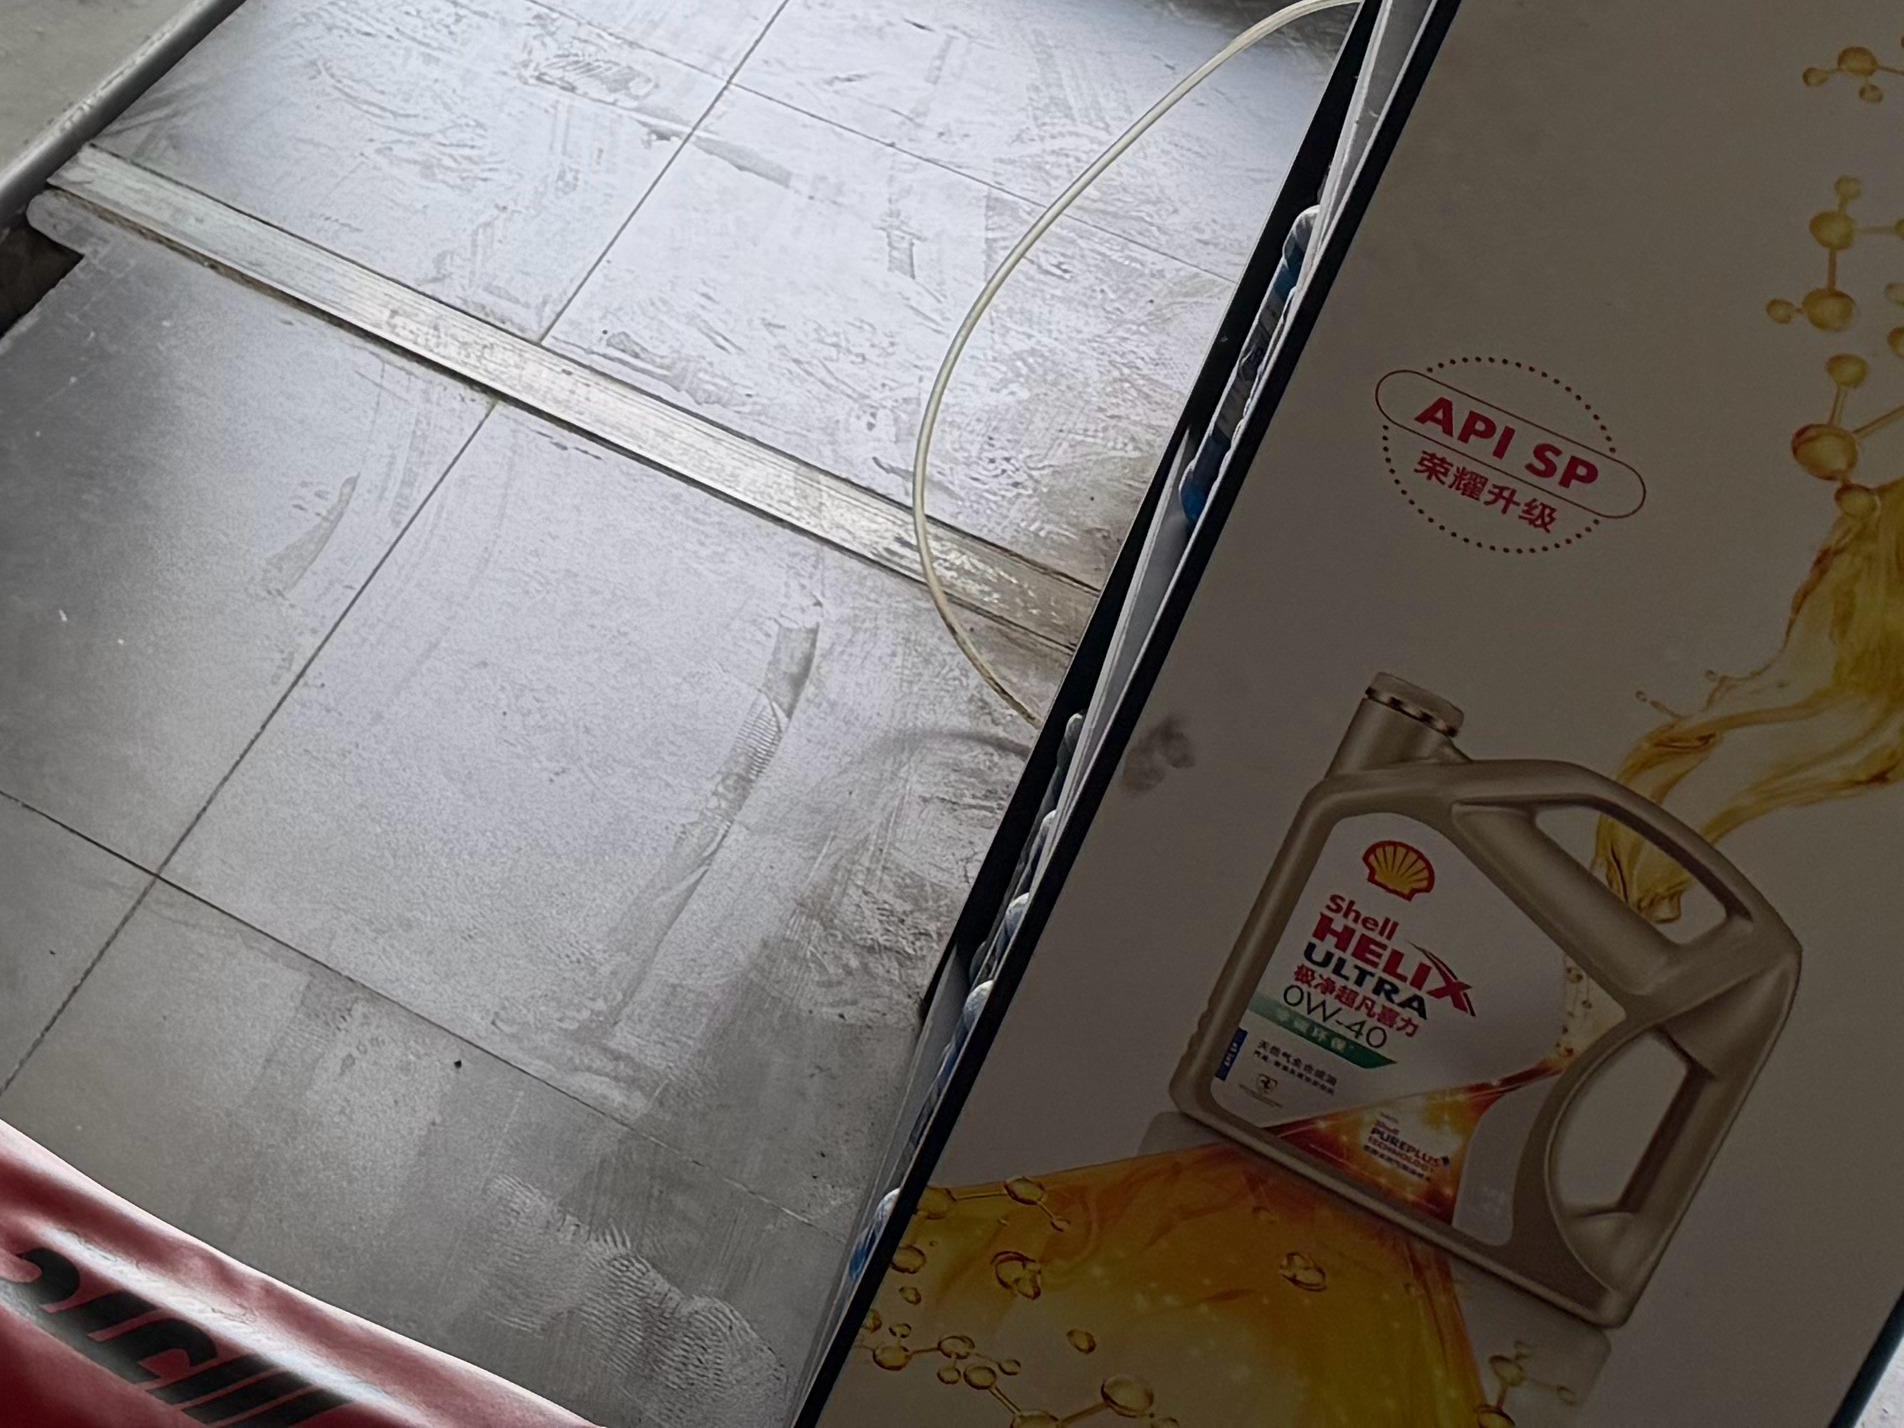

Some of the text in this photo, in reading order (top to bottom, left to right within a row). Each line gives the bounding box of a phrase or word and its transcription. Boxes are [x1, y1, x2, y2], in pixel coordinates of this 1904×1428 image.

[1414, 396, 1599, 489] API SP
[1413, 450, 1557, 534] 荣耀升级
[1326, 894, 1399, 941] Shell
[1294, 963, 1420, 1038] 极净超凡喜力
[1303, 941, 1428, 1020] ULTRA
[1311, 911, 1476, 1018] HELIX
[1283, 984, 1388, 1049] 0W-40
[1367, 1135, 1437, 1174] TECHNOLOGY
[1370, 1127, 1443, 1168] PUREPLUS
